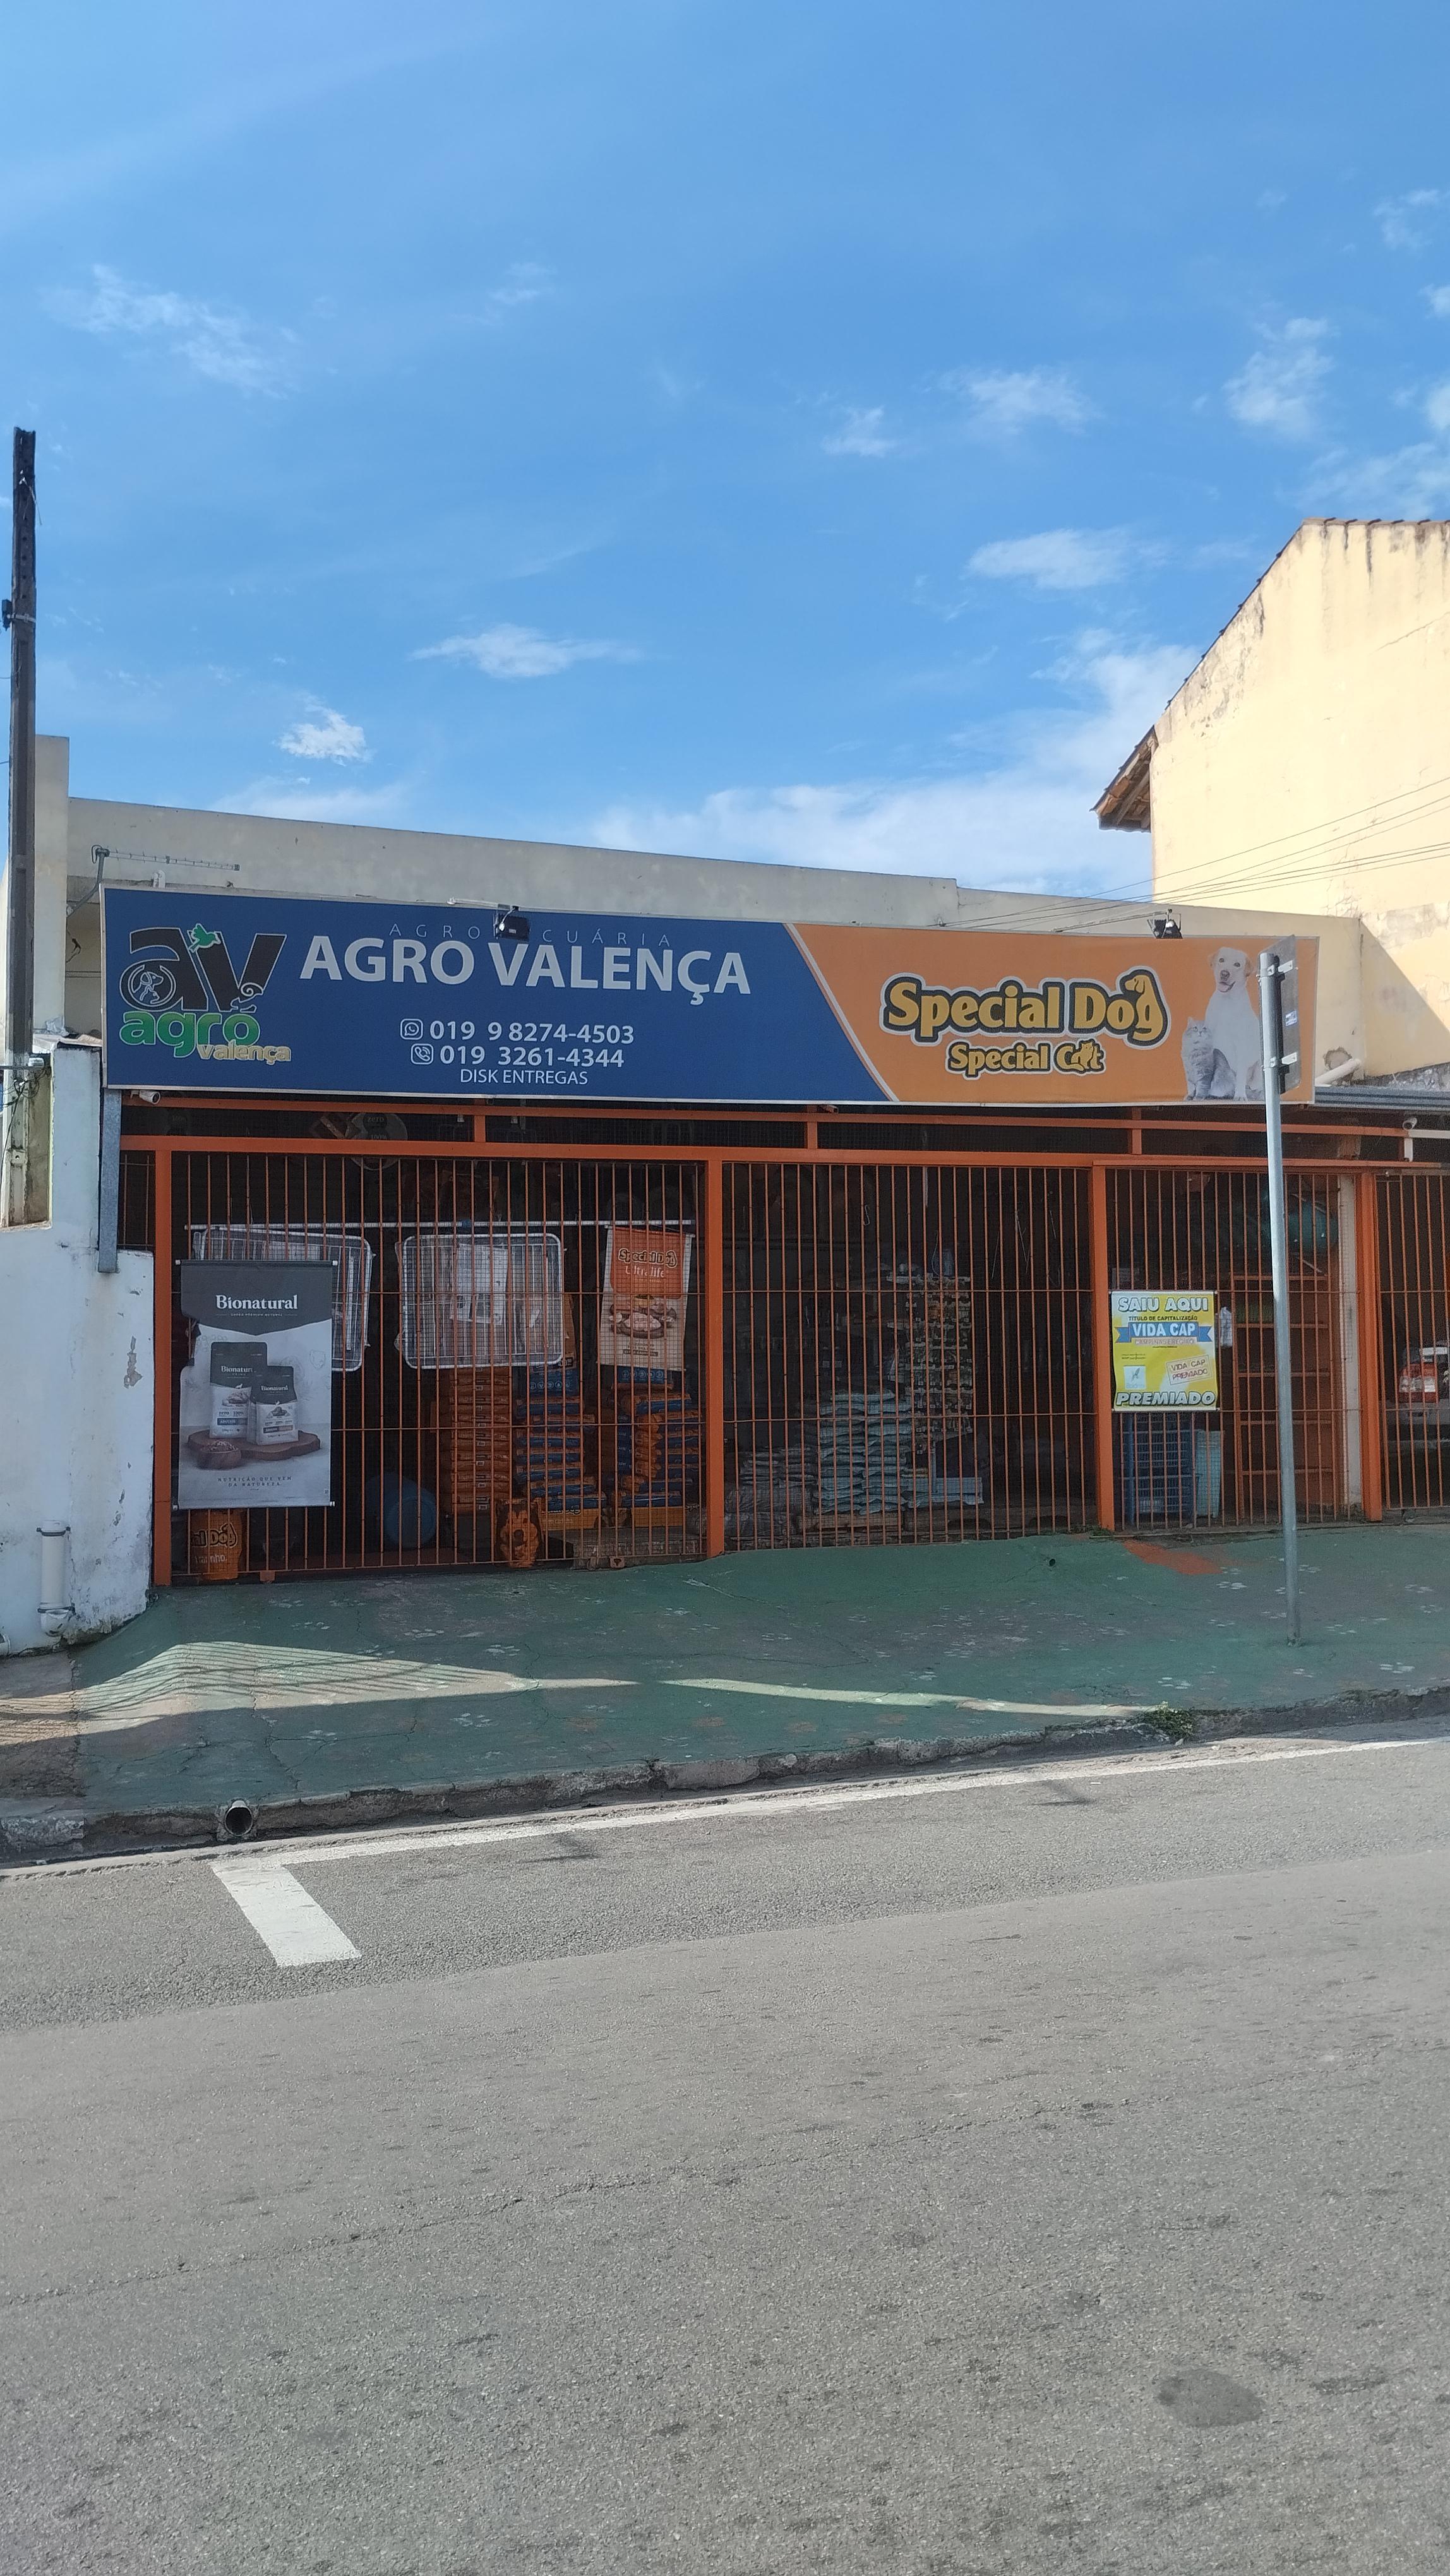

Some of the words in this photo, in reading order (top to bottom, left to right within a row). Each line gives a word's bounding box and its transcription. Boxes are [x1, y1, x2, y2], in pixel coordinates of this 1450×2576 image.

[389, 922, 670, 947] AGROCUÁRIA
[299, 935, 475, 985] AGRO
[488, 941, 752, 1006] VALENÇA
[883, 977, 1064, 1042] Special
[1070, 970, 1168, 1046] Dog
[119, 1010, 260, 1058] agro
[430, 1020, 476, 1041] 019
[196, 1039, 291, 1065] valença
[440, 1045, 486, 1065] 019
[497, 1046, 625, 1068] 3261-4344
[947, 1041, 1049, 1077] Special
[1054, 1040, 1105, 1074] Cat
[460, 1068, 499, 1084] DISK
[503, 1070, 589, 1085] ENTREGAS
[215, 1294, 298, 1310] Bionatural
[1118, 1297, 1159, 1312] SAIU
[1165, 1297, 1208, 1312] AQUI
[1132, 1323, 1166, 1337] VIDA
[1170, 1323, 1195, 1336] CAP
[1171, 1363, 1188, 1371] VIDA
[1116, 1392, 1215, 1407] PREMIADO
